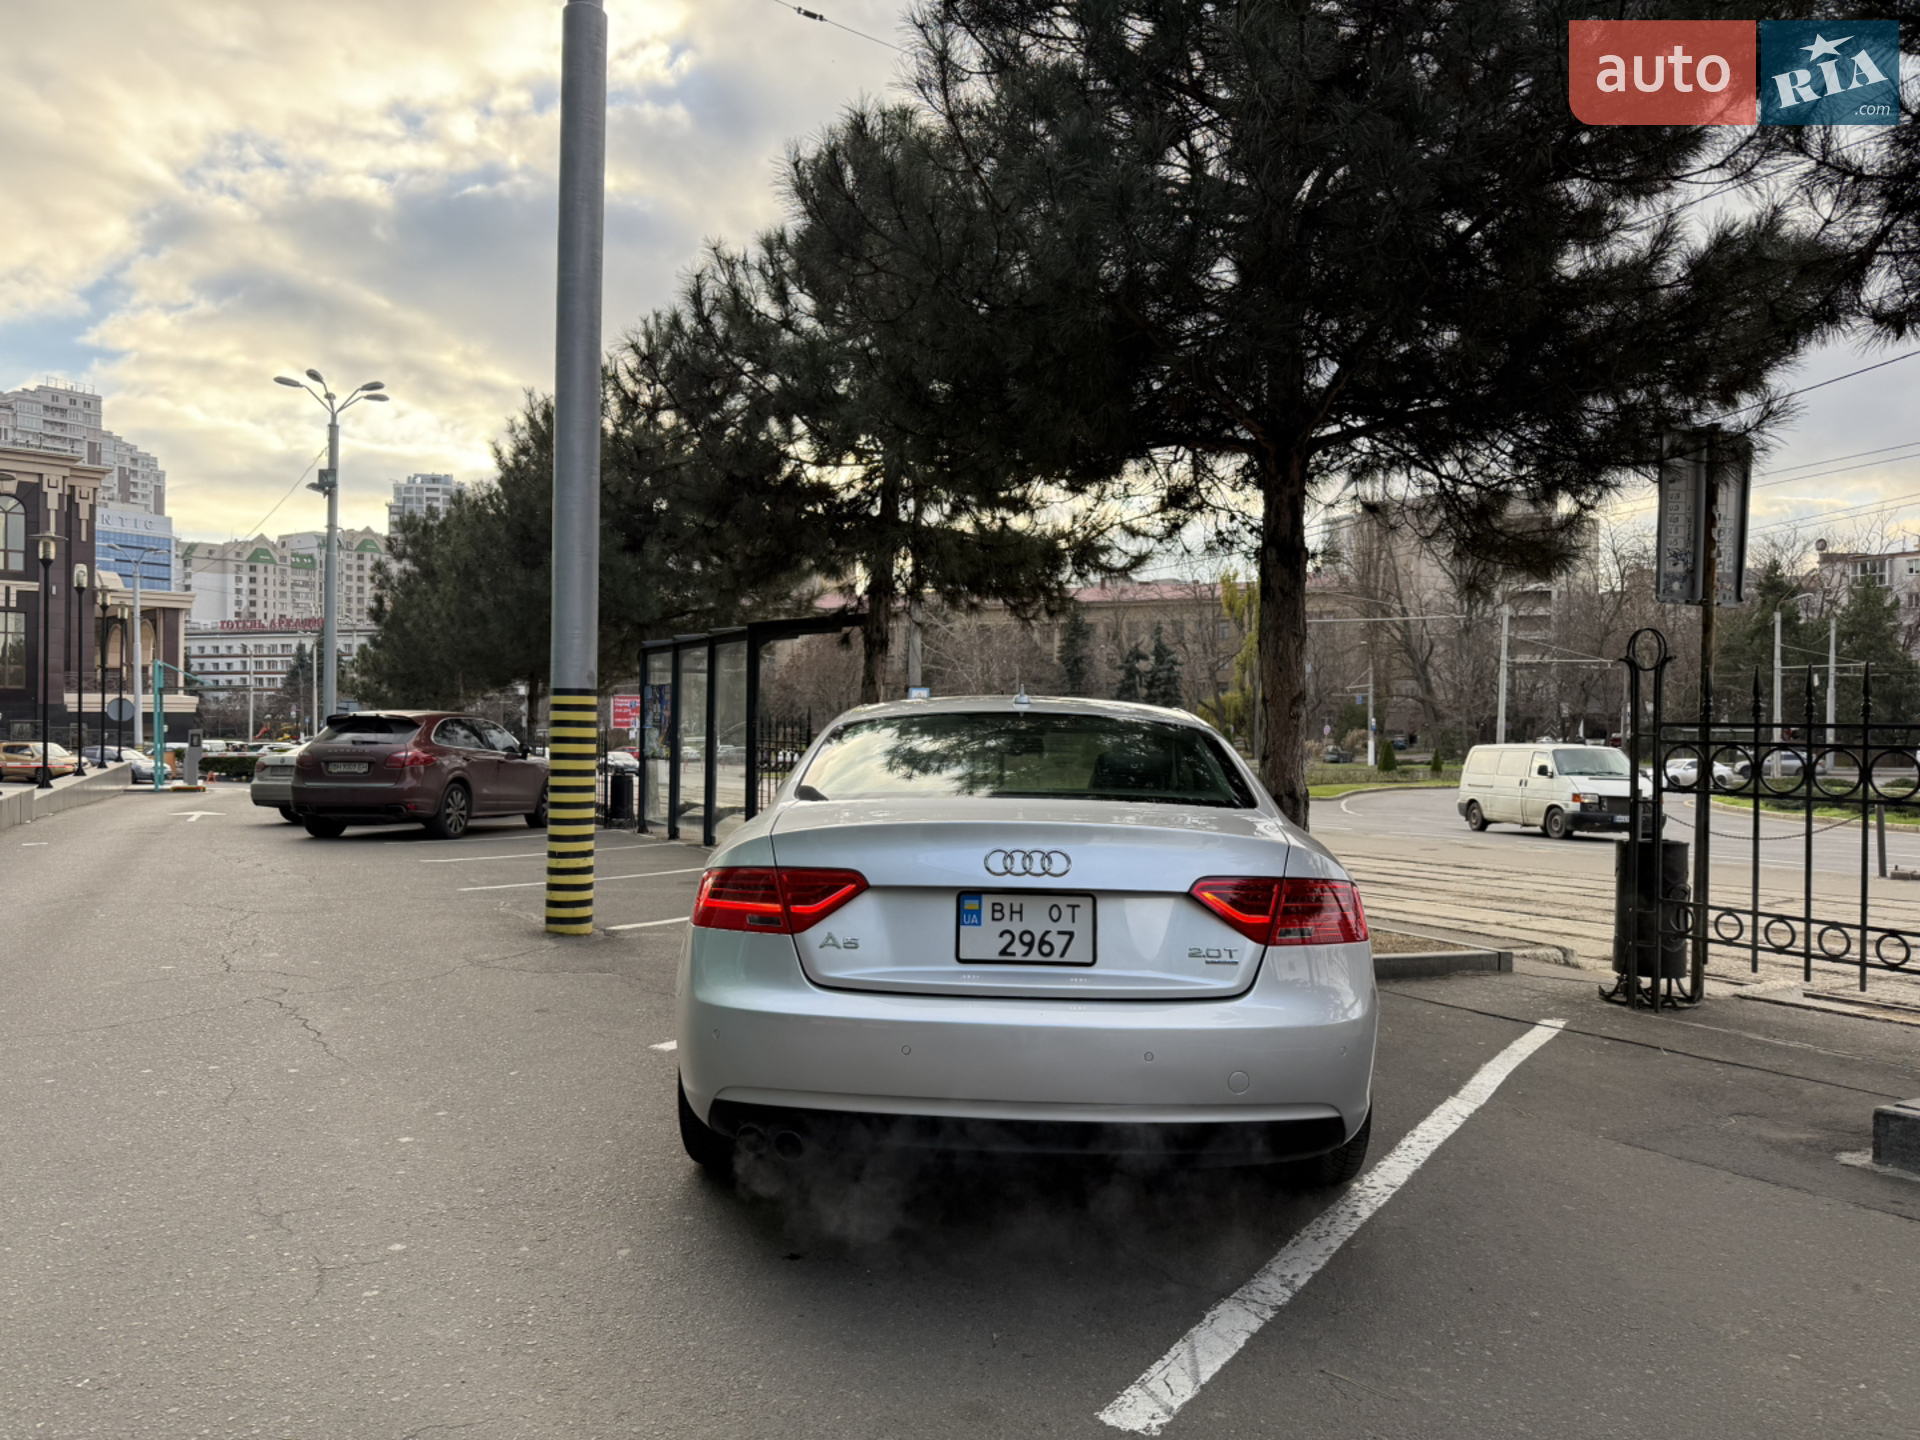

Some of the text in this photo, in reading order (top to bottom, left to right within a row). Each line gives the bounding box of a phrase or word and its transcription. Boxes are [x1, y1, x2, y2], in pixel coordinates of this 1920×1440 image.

[963, 914, 979, 925] UA
[991, 902, 1024, 923] BH
[818, 931, 860, 950] A5
[998, 929, 1075, 959] 2967
